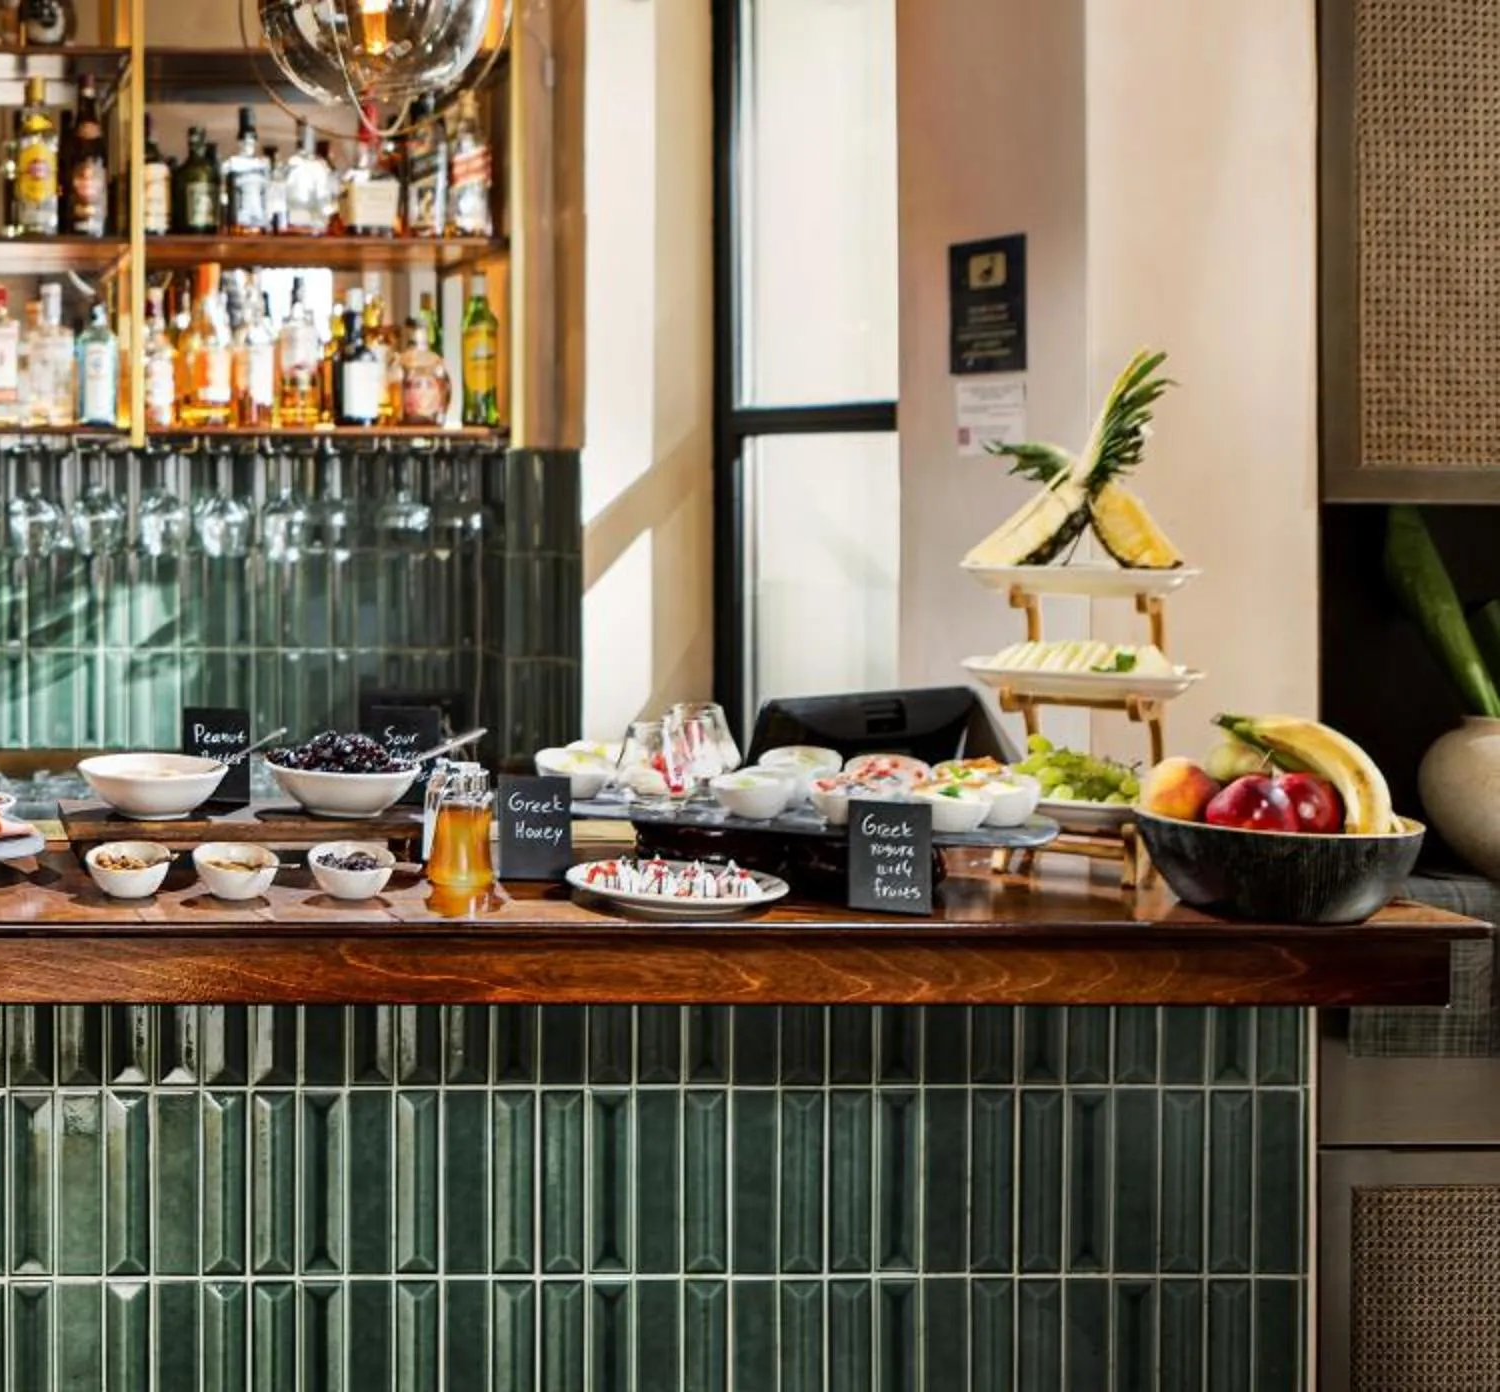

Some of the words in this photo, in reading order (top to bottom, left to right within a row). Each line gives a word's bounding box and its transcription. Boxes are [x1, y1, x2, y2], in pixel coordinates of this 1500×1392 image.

[193, 723, 247, 744] Peanut
[383, 724, 420, 747] Sour
[508, 791, 565, 813] Greek
[515, 819, 563, 847] Honey
[861, 813, 915, 838] Greek
